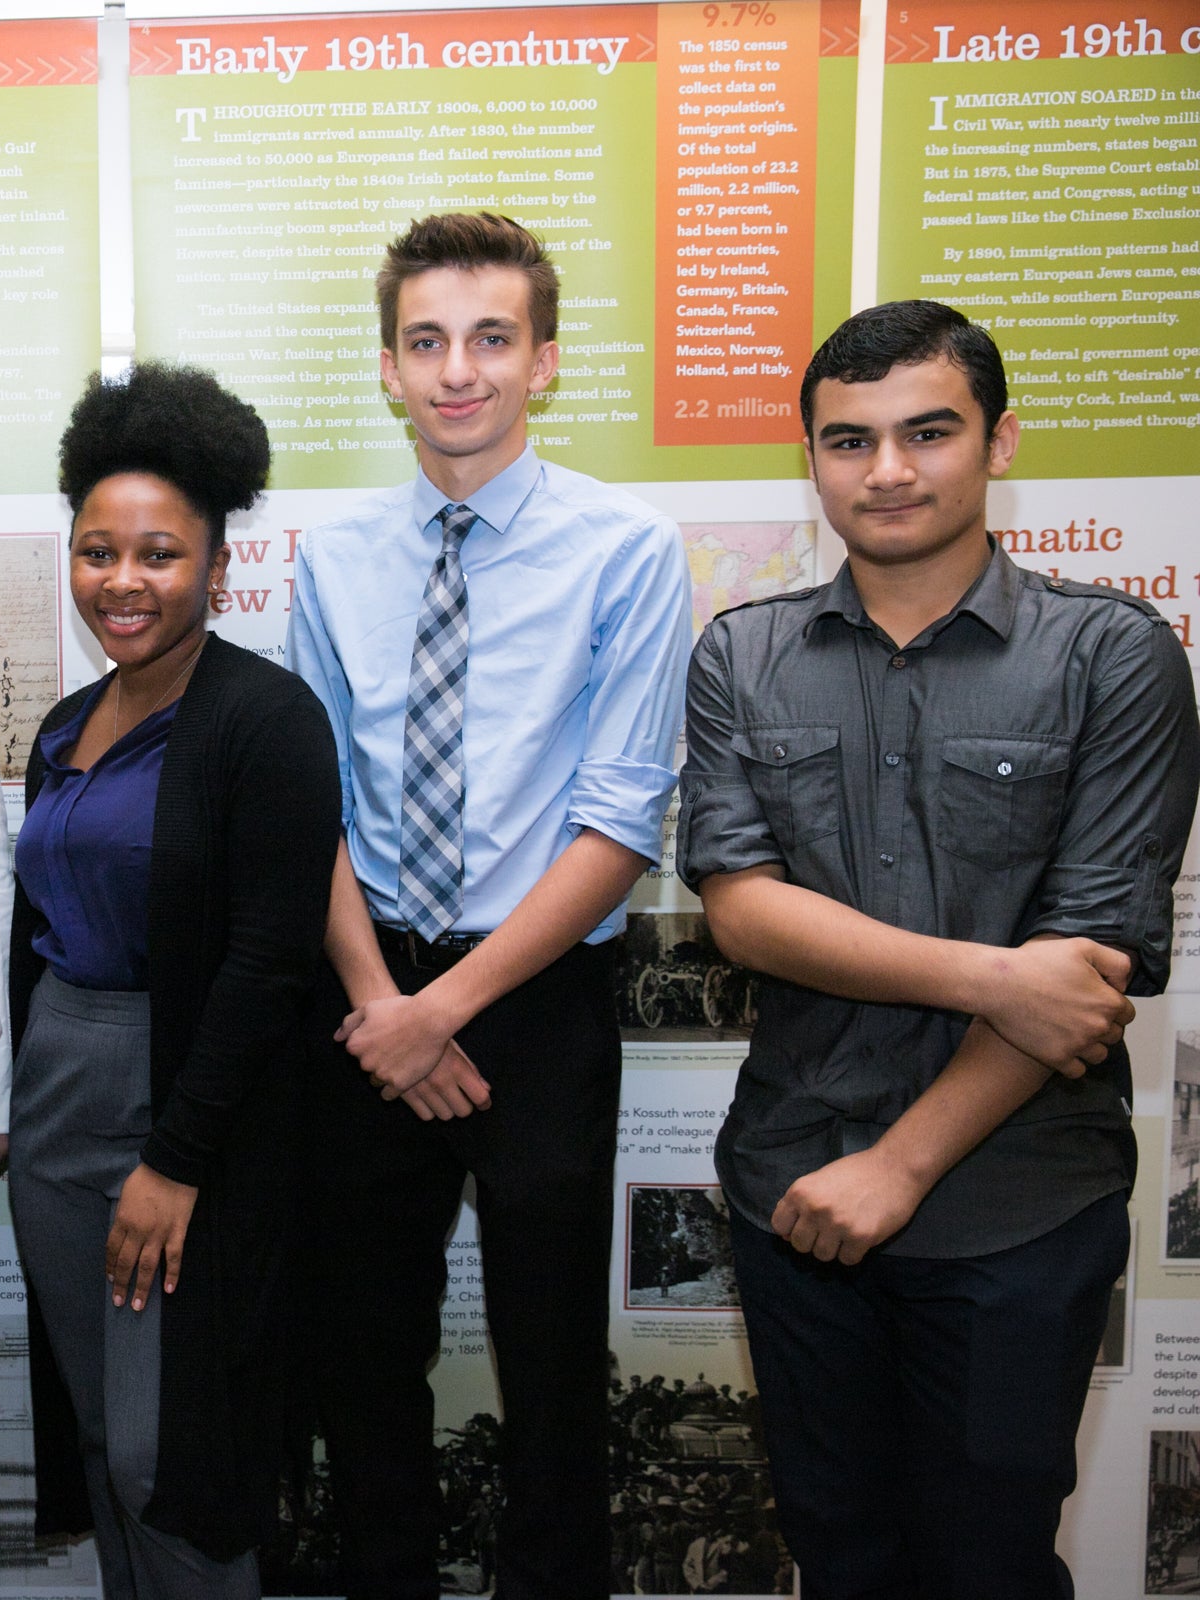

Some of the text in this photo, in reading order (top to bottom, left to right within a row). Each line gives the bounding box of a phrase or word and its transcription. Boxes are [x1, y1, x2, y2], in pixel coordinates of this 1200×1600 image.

[702, 2, 776, 28] 9.7%
[900, 10, 908, 24] 5
[679, 39, 787, 52] The 1850 census
[932, 17, 1167, 63] Late 19th
[176, 30, 629, 83] Early 19th century
[678, 58, 780, 73] was the first to
[678, 79, 776, 94] collect data on
[1080, 88, 1176, 104] SOARED in
[330, 98, 597, 116] THE EARLY 1800s, 6,000 to 10,000
[678, 100, 785, 117] the population’s
[678, 120, 797, 137] immigrant origins.
[677, 141, 756, 155] Of the total
[677, 160, 798, 179] population of 23.2
[923, 161, 1152, 179] But in 1875, the Supreme Court
[677, 181, 799, 196] million, 2.2 million,
[676, 203, 772, 218] or 9.7 percent,
[677, 222, 787, 236] had been born in
[676, 242, 779, 256] other countries,
[676, 262, 769, 279] led by Ireland,
[676, 282, 788, 298] Germany, Britain,
[676, 303, 778, 317] Canada, France,
[995, 311, 1179, 328] for economic opportunity.
[676, 322, 755, 336] Switzerland,
[676, 343, 783, 357] Mexico, Norway,
[676, 362, 792, 377] Holland, and Italy.
[674, 397, 791, 418] 2.2 million
[632, 1107, 715, 1118] Kossuth wrote
[630, 1124, 643, 1135] of
[458, 1344, 486, 1356] 1869.
[1154, 1352, 1174, 1362] the
[1152, 1404, 1174, 1414] and
